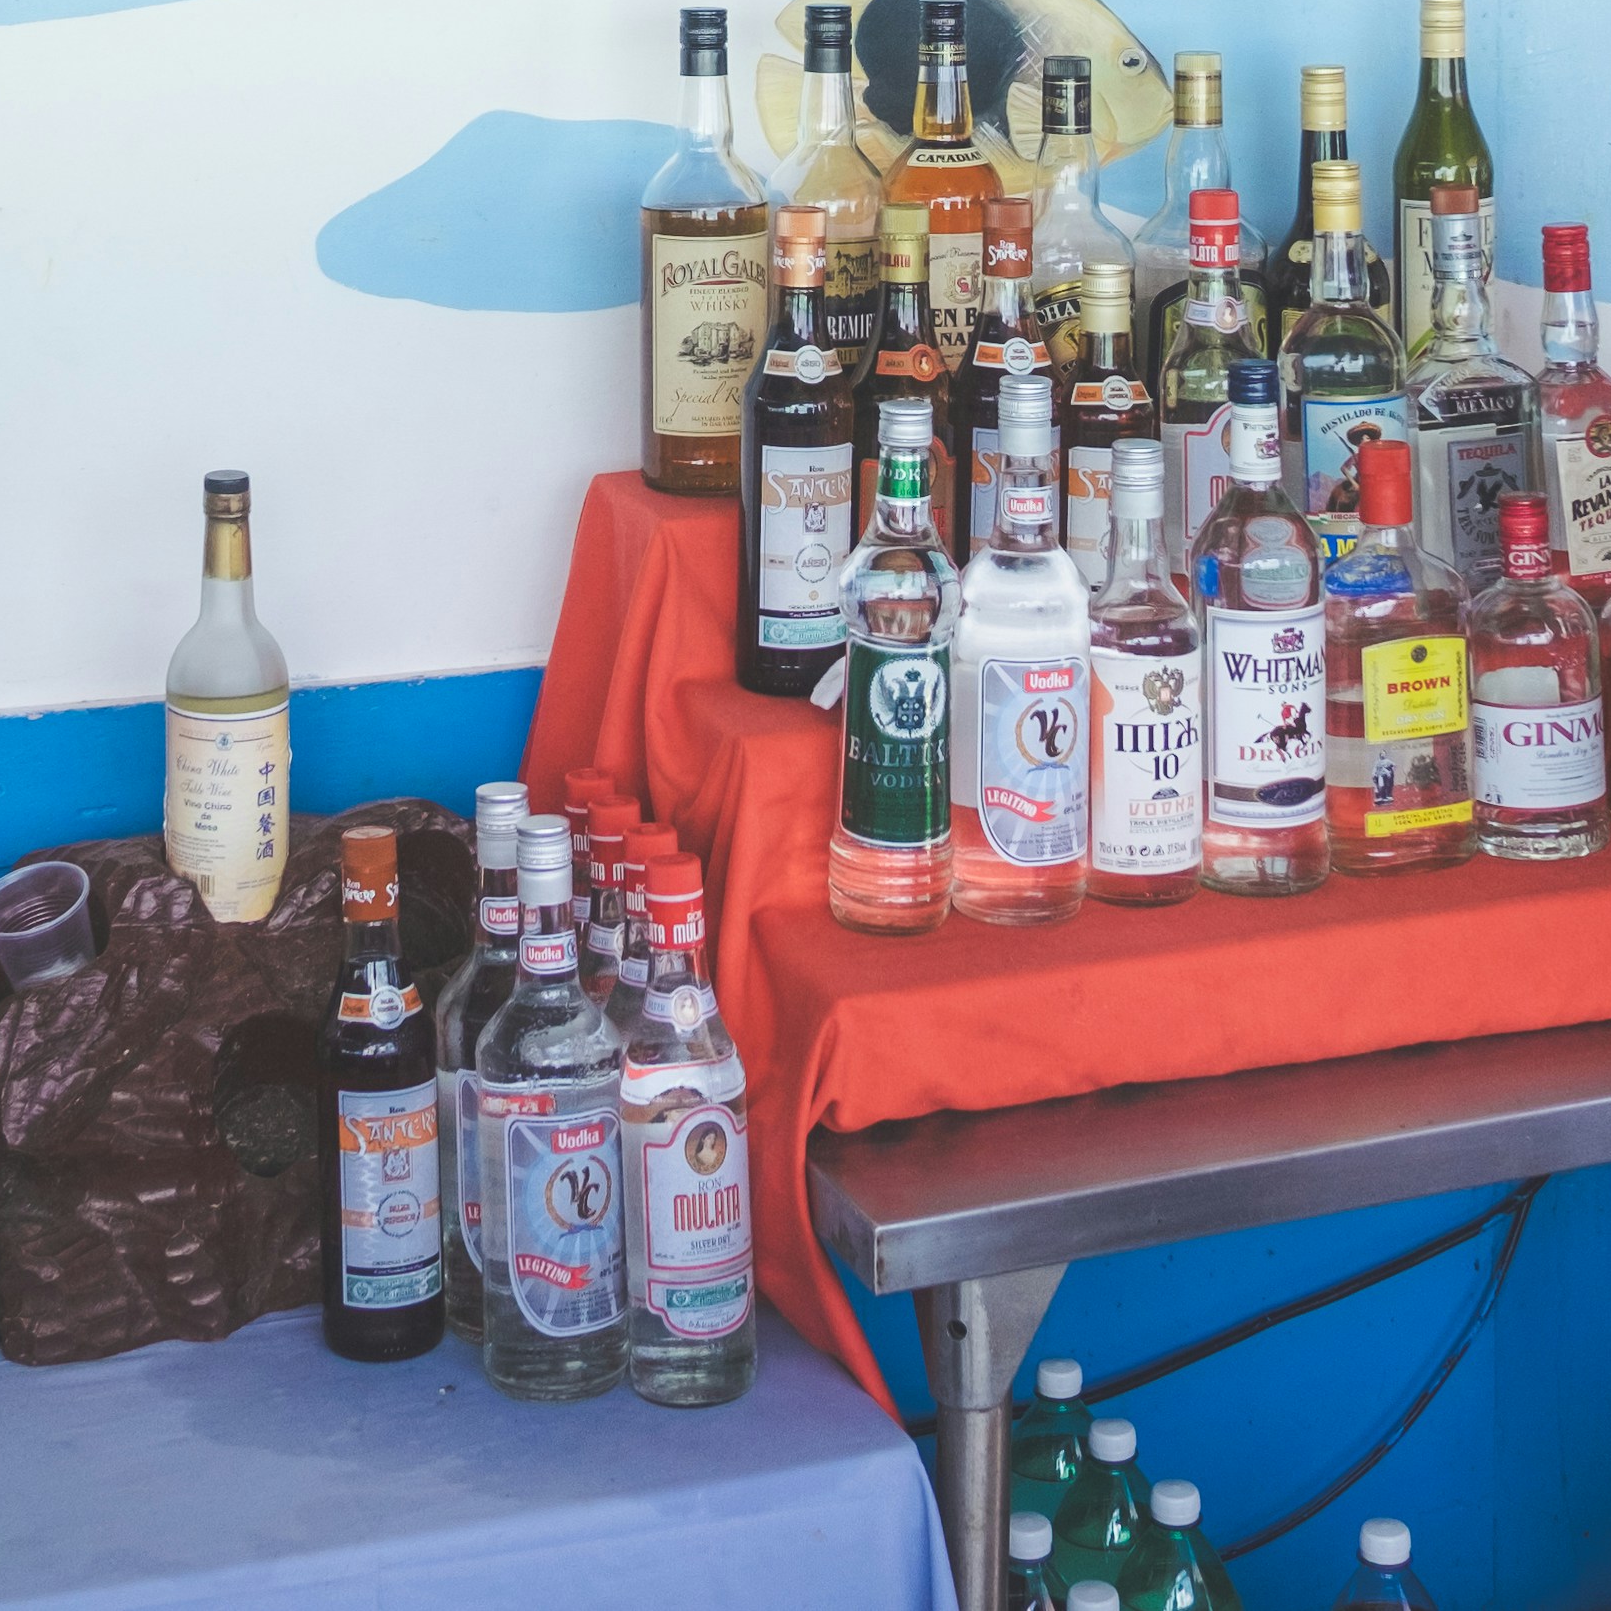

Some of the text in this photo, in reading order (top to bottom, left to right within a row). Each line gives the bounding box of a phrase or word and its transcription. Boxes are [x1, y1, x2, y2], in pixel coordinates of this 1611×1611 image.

[690, 298, 749, 311] WHISKY
[671, 381, 727, 417] Special
[1456, 395, 1515, 414] MEXICO
[1457, 443, 1518, 460] TEQUILA
[1599, 475, 1611, 489] LA
[1011, 499, 1043, 513] Vodka
[1029, 672, 1069, 690] Vodka
[1268, 680, 1308, 694] SONS
[1387, 676, 1451, 695] BROWN
[849, 735, 950, 768] BALTIK
[1238, 745, 1286, 763] DRY
[1152, 753, 1179, 781] 10
[871, 772, 942, 788] VODKA
[986, 789, 1038, 818] LEGITIMO
[626, 892, 646, 912] MUL
[528, 947, 562, 962] Vodka
[557, 1128, 600, 1150] Vodka
[698, 1177, 722, 1192] RON
[674, 1183, 741, 1232] MULATA
[518, 1255, 572, 1285] LEGITIMO
